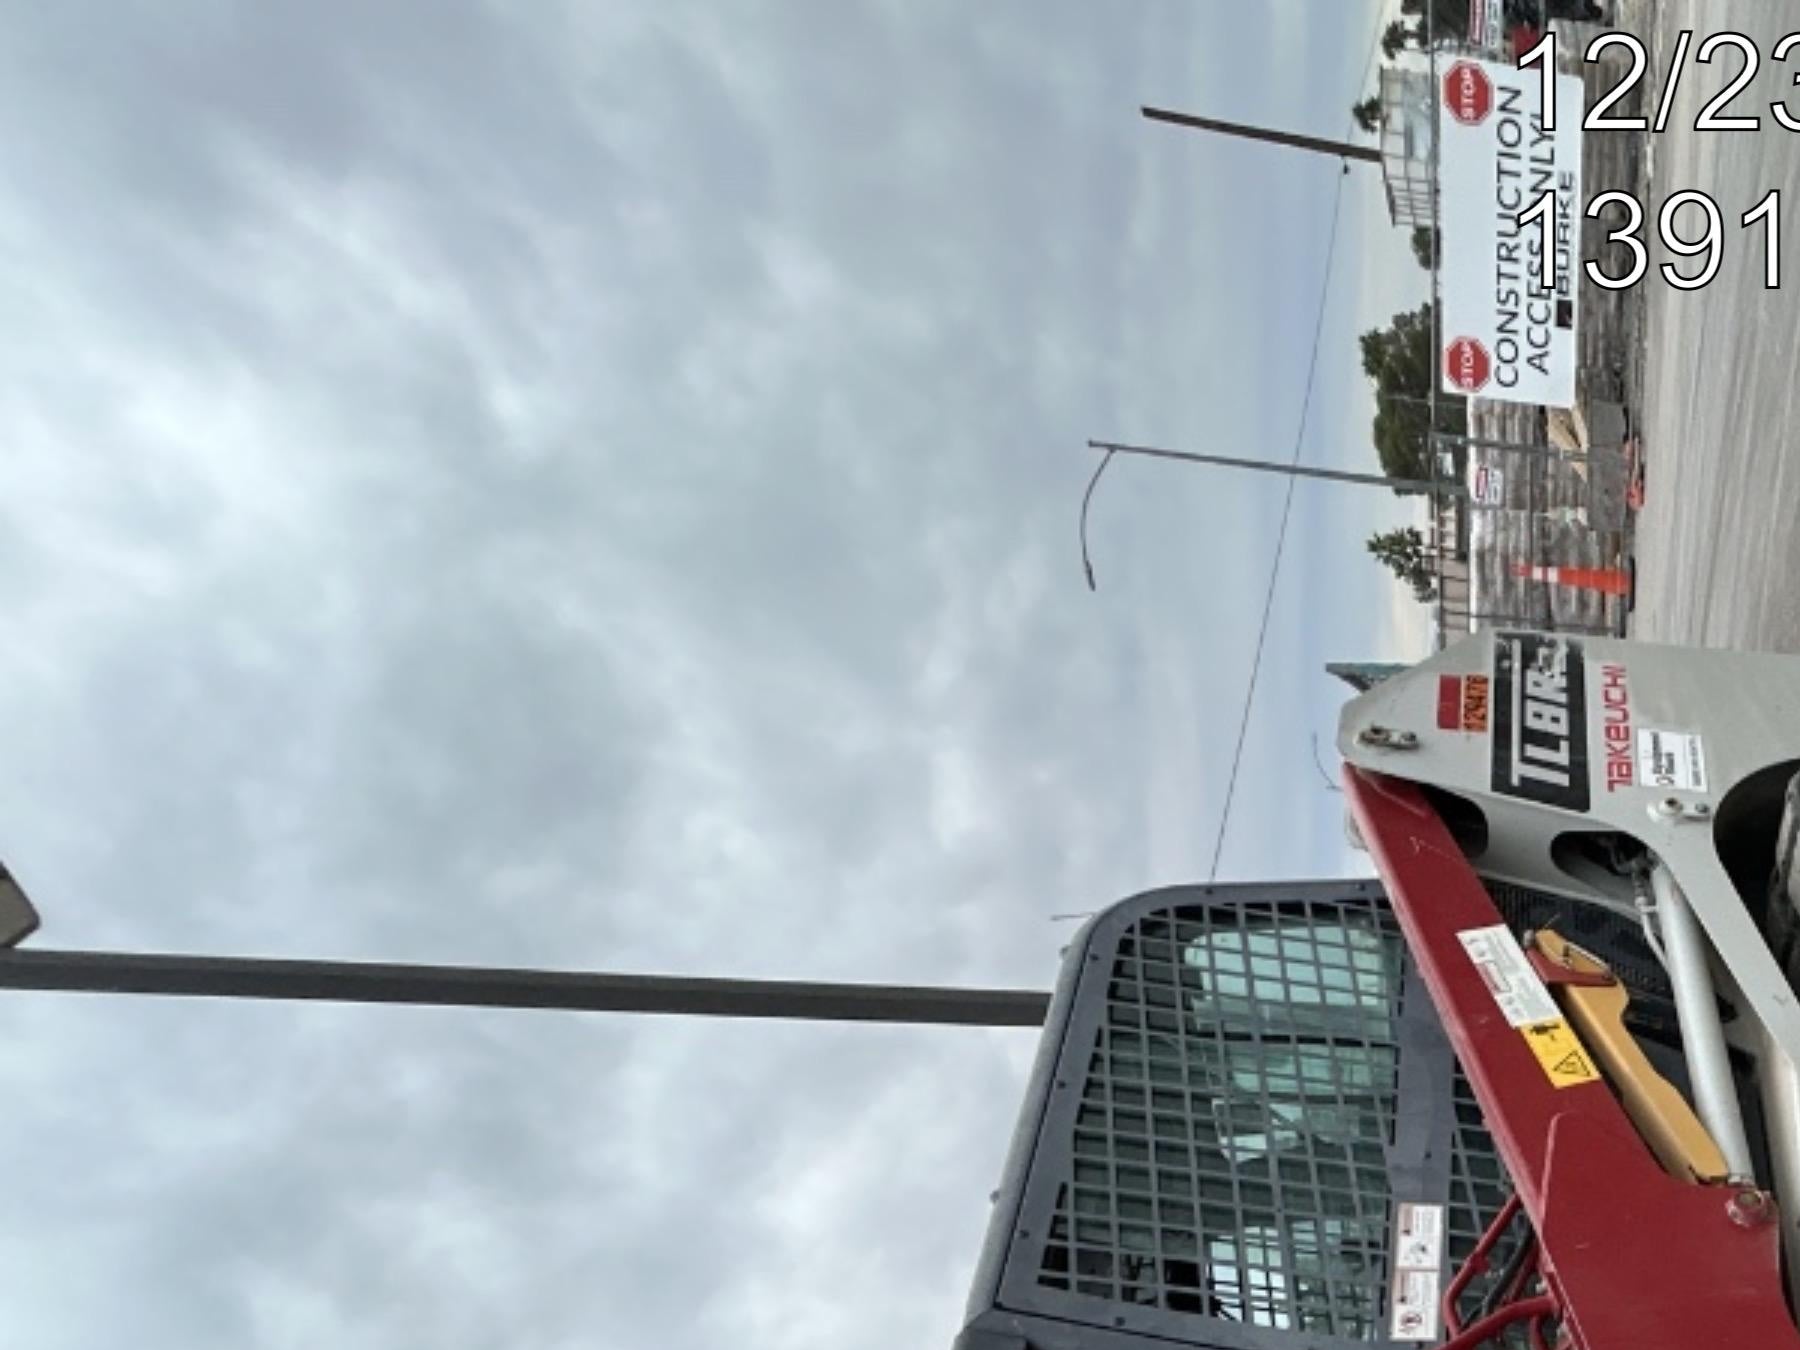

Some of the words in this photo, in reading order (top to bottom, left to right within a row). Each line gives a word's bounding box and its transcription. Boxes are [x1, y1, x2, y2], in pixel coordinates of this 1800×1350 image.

[1459, 67, 1476, 120] STOP
[1495, 85, 1523, 388] CONSTRUCTION
[1556, 170, 1574, 298] BURKE
[1460, 340, 1475, 389] STOP
[1600, 665, 1633, 793] TAKEUCHI
